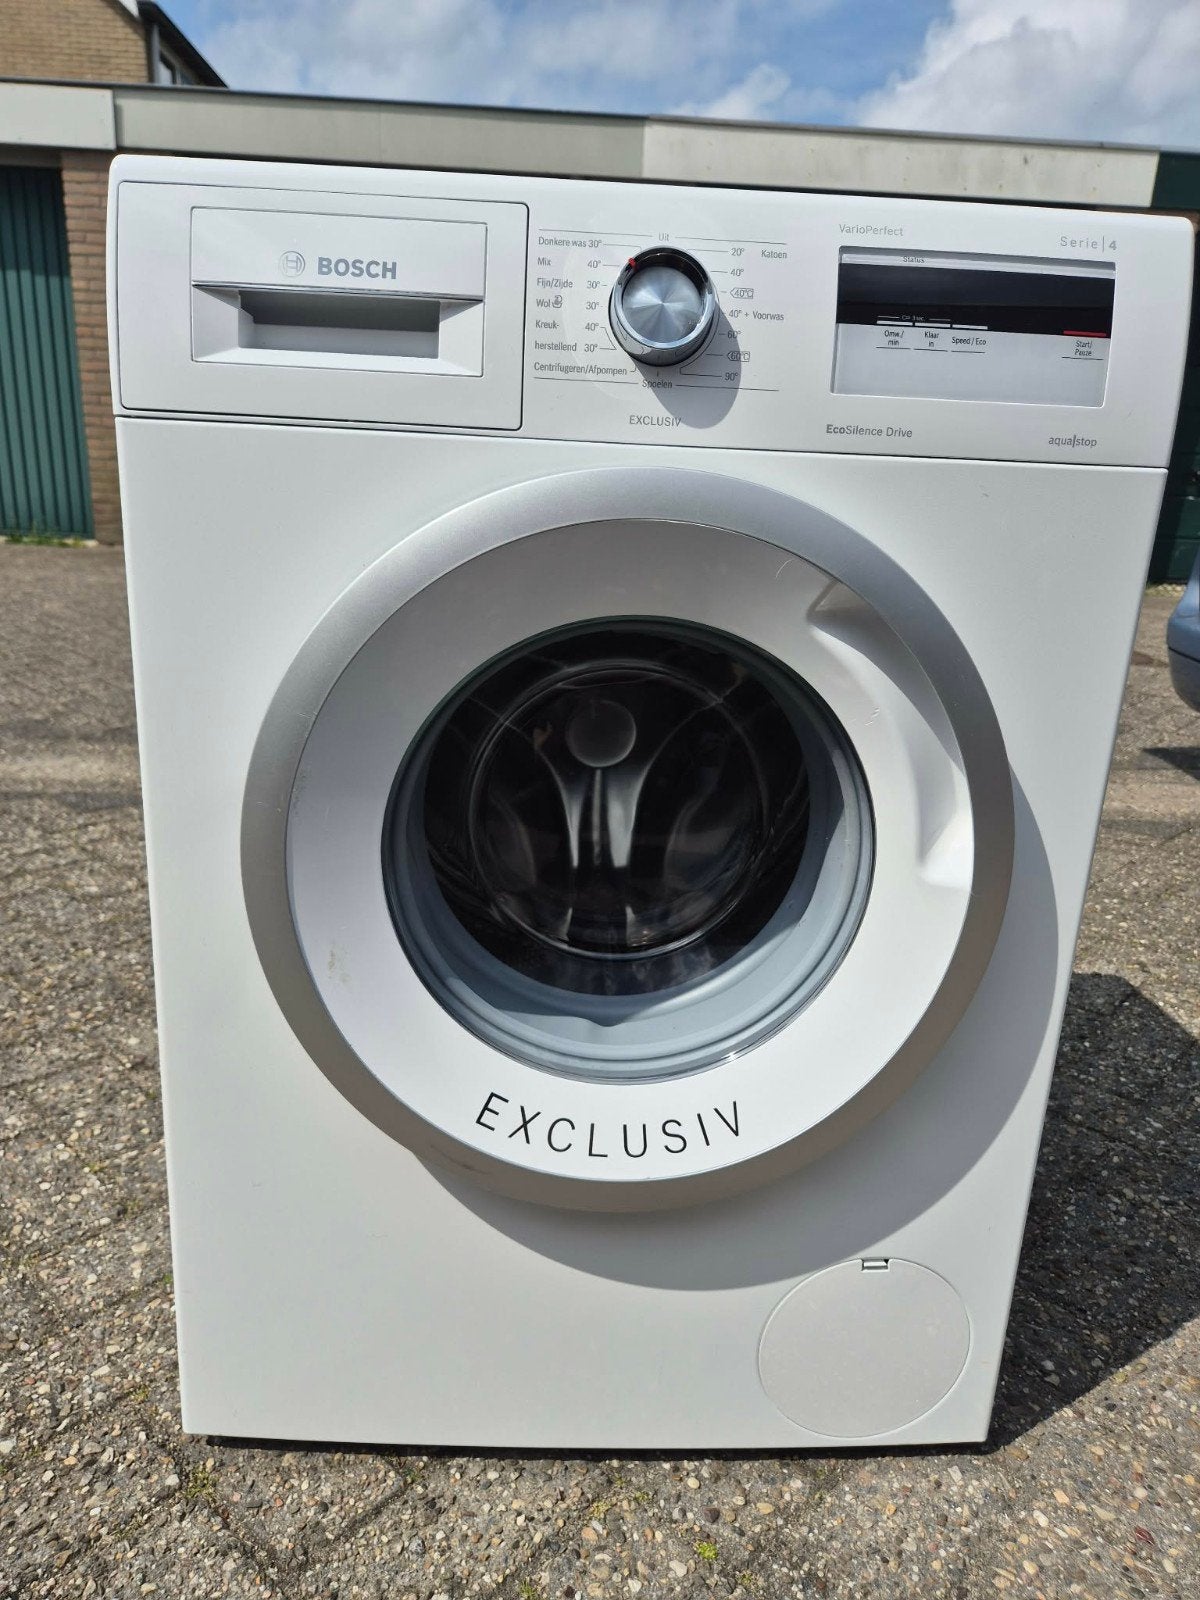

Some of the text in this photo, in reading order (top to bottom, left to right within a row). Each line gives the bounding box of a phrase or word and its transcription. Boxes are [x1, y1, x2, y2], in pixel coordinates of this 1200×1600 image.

[839, 224, 904, 237] VarioPerfect
[538, 236, 570, 247] Donkere
[572, 240, 587, 248] was
[658, 233, 670, 242] Uit
[1060, 236, 1098, 250] Serie
[731, 247, 745, 256] 20°
[761, 249, 787, 259] Katoen
[537, 257, 551, 266] Mix
[903, 255, 925, 263] Status
[317, 256, 397, 280] BOSCH
[587, 260, 601, 269] 40°
[730, 268, 744, 277] 40°
[537, 277, 573, 289] Fijn/Zijde
[587, 281, 600, 290] 30°
[536, 299, 551, 308] Wol
[586, 301, 600, 310] 30°
[752, 310, 784, 321] Voorwas
[535, 320, 560, 330] Kreuk-
[585, 322, 600, 332] 40°
[924, 331, 940, 339] Klaar
[535, 341, 577, 352] herstellend
[584, 344, 598, 353] 30°
[642, 379, 673, 390] Spoelen
[629, 415, 682, 428] EXCLUSIV
[826, 424, 913, 438] EcoSilence Drive
[475, 1092, 740, 1158] EXCLUSIV
